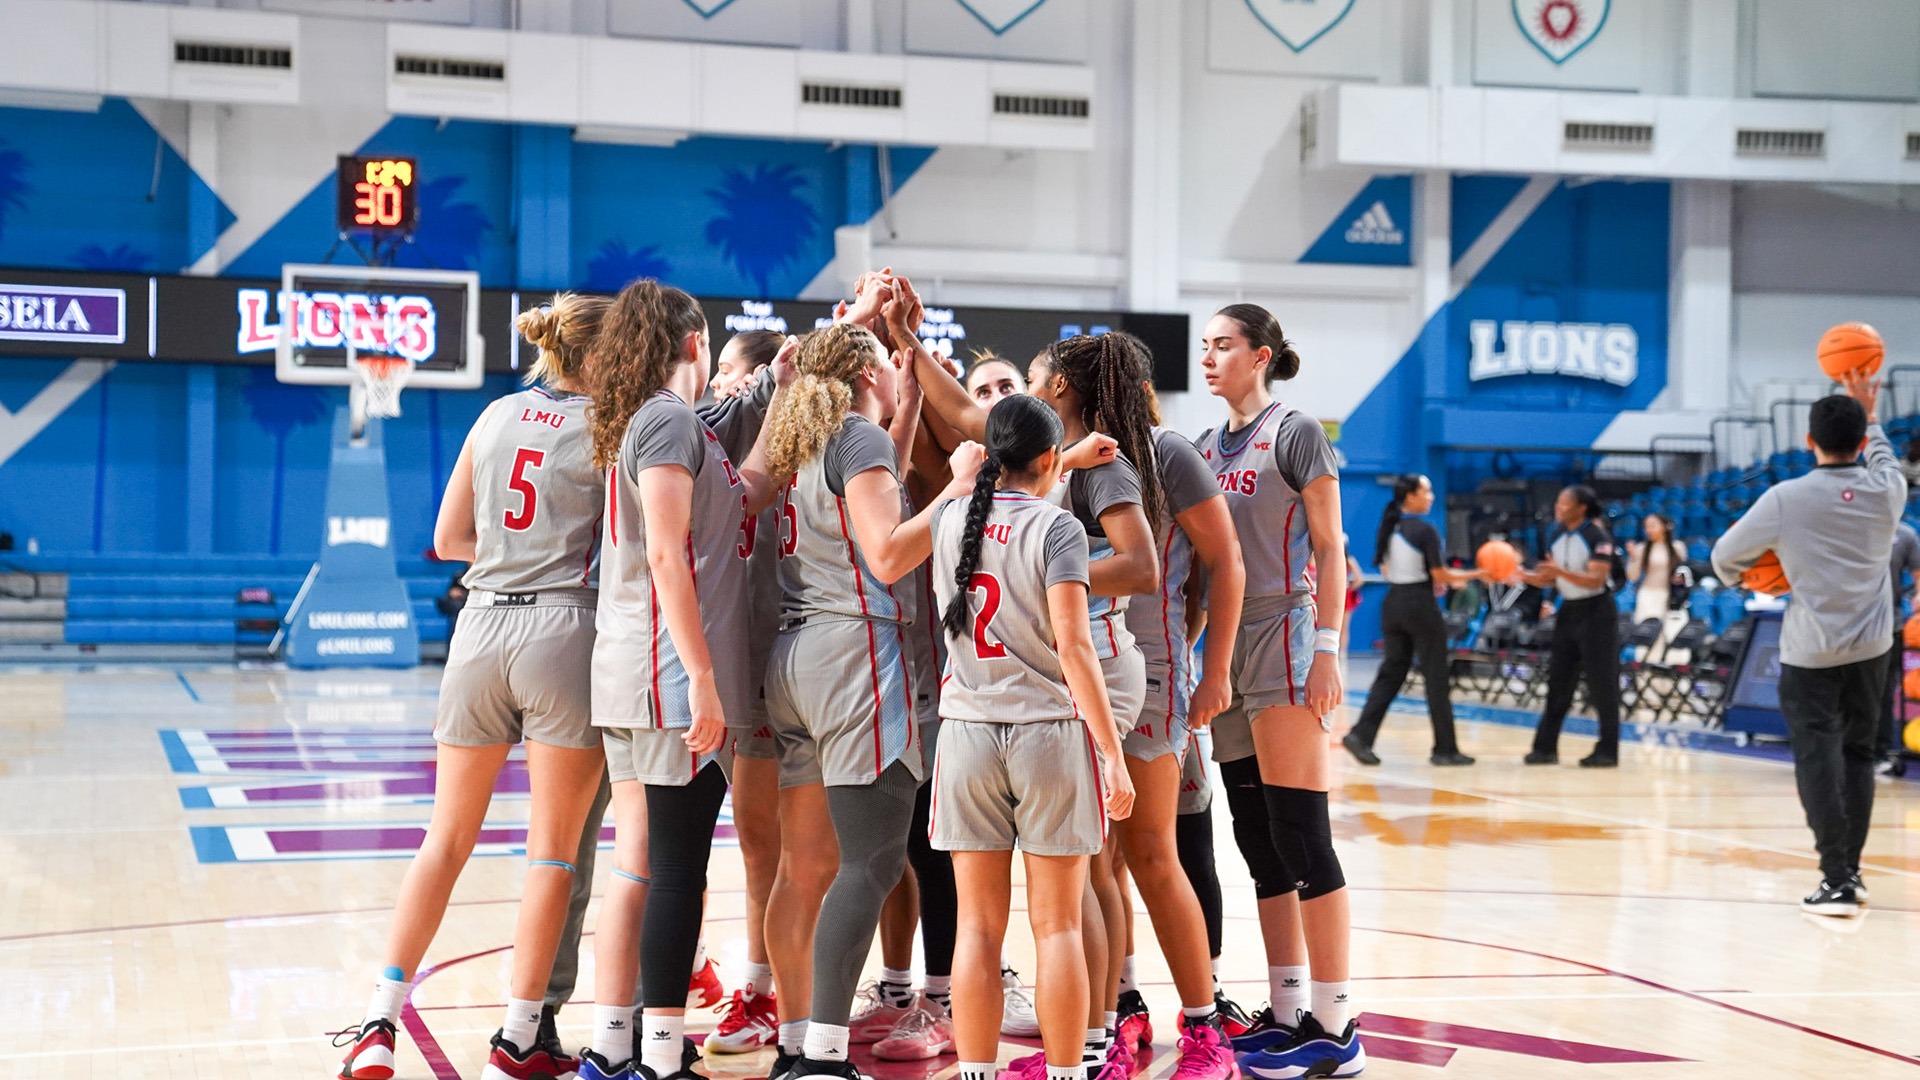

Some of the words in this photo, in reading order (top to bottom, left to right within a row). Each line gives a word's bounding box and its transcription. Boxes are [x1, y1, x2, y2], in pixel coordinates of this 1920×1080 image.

[355, 182, 402, 226] 30
[238, 288, 436, 362] LIONS
[1470, 319, 1638, 387] LIONS
[521, 408, 566, 430] LMU
[503, 446, 547, 533] 5
[328, 516, 390, 549] LMU
[982, 522, 1012, 546] MU
[966, 571, 1010, 661] 2
